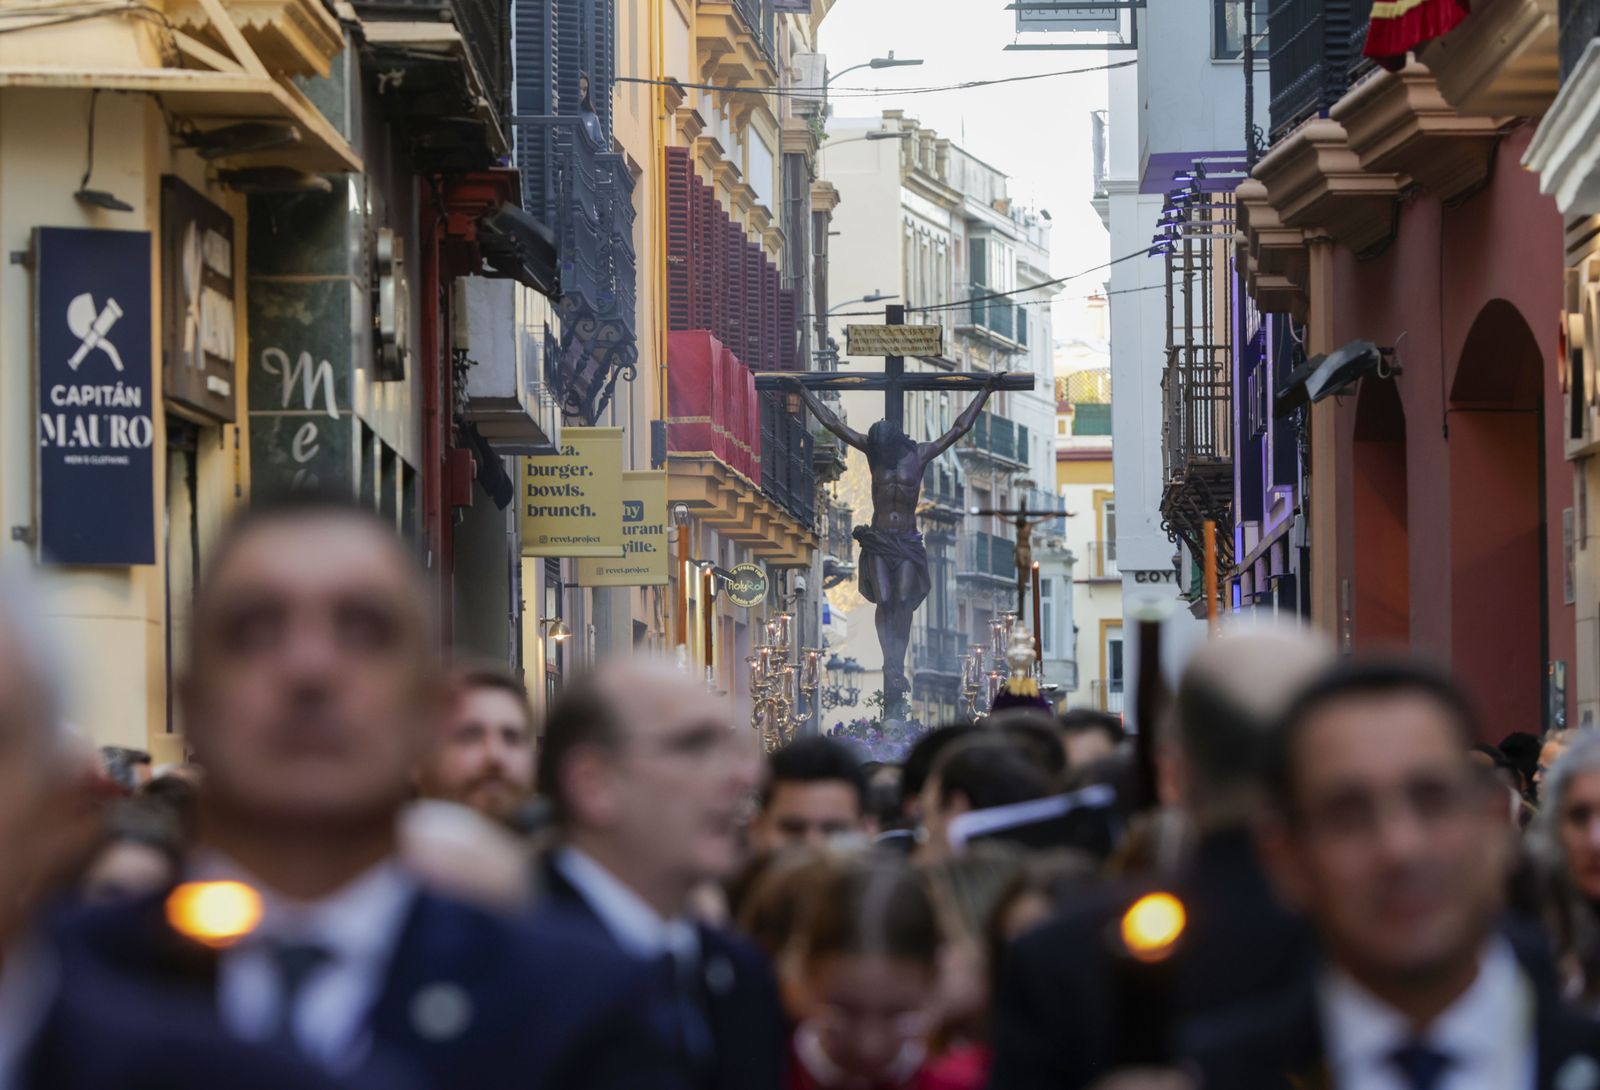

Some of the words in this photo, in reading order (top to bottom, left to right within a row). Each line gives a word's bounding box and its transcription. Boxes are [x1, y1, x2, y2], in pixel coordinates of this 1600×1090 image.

[50, 381, 142, 408] CAPITÁN
[40, 413, 154, 448] MAURO
[527, 464, 593, 479] burger.
[527, 483, 585, 497] bowls.
[527, 504, 596, 517] brunch.
